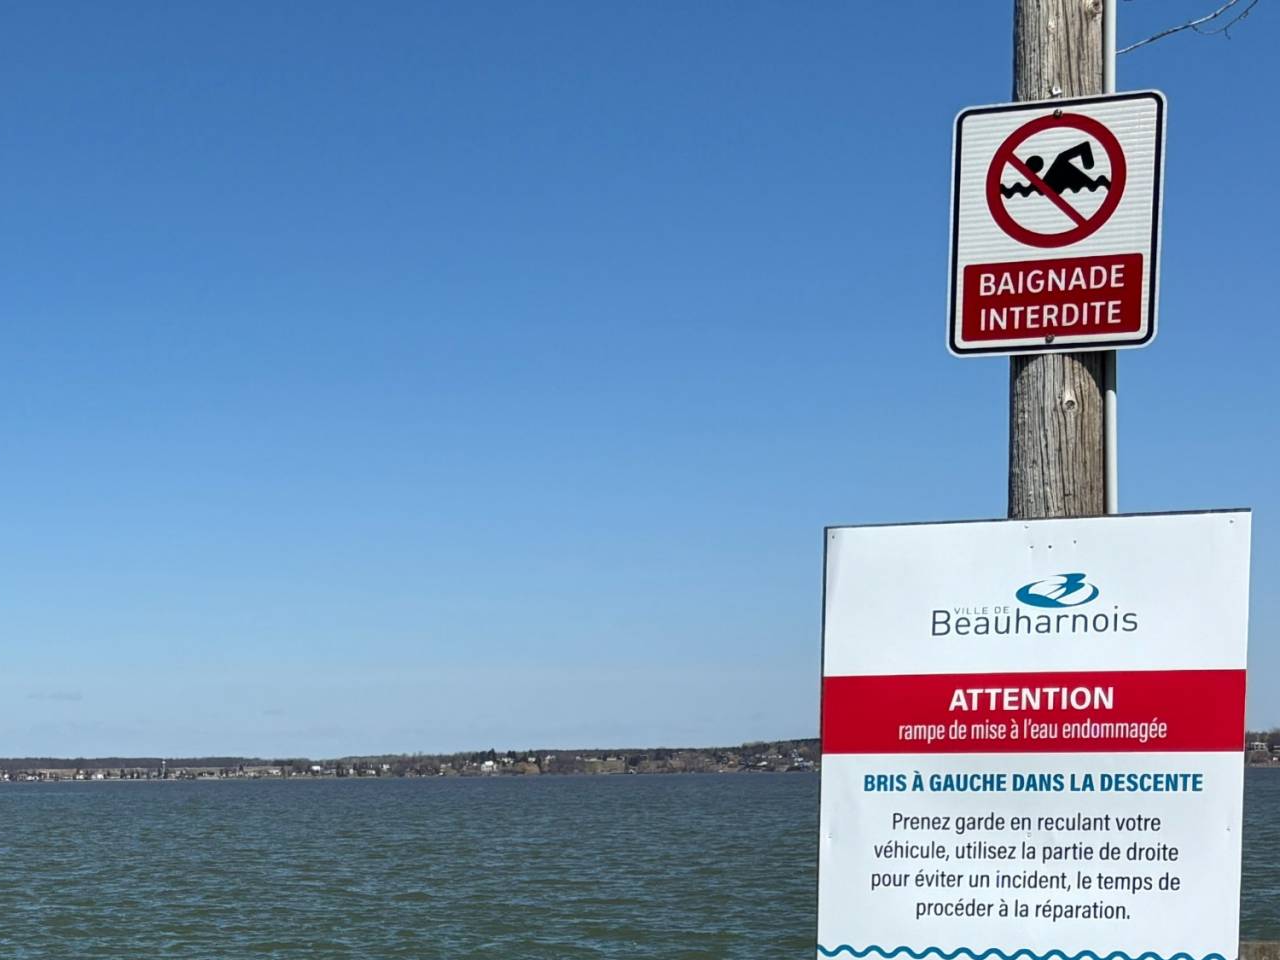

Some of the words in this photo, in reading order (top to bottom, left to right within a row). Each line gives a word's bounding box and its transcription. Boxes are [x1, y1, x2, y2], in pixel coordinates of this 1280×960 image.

[979, 264, 1126, 297] BAIGNADE
[980, 300, 1122, 332] INTERDITE
[931, 605, 1138, 636] Beauharnois
[953, 606, 989, 616] VILLE
[993, 605, 1010, 615] DE
[948, 686, 1114, 712] ATTENTION
[898, 724, 946, 744] rampe
[948, 719, 967, 740] de
[970, 719, 1007, 740] mise
[1009, 718, 1019, 740] à
[1023, 718, 1058, 740] l'eau
[1062, 717, 1168, 743] endommagée
[863, 773, 908, 792] BRIS
[911, 770, 925, 792] À
[929, 773, 1007, 792] GAUCHE
[1013, 773, 1065, 792] DANS
[1070, 773, 1095, 792] LA
[1100, 773, 1204, 792] DESCENTE
[892, 812, 951, 831] Prenez
[955, 812, 1006, 835] garde
[1010, 816, 1032, 831] en
[1037, 812, 1111, 832] reculant
[1115, 814, 1161, 832] votre
[873, 839, 950, 862] véhicule,
[955, 840, 1017, 860] utilisez
[1021, 841, 1036, 860] la
[1042, 841, 1094, 865] partie
[1098, 841, 1121, 861] de
[1126, 841, 1179, 862] droite
[871, 873, 911, 892] pour
[914, 869, 964, 888] éviter
[968, 873, 990, 888] un
[995, 870, 1071, 892] incident,
[1076, 870, 1092, 890] le
[1096, 872, 1153, 895] temps
[1158, 871, 1181, 891] de
[916, 898, 994, 920] procéder
[998, 898, 1009, 917] à
[1014, 898, 1029, 918] la
[1034, 899, 1131, 922] réparation.
